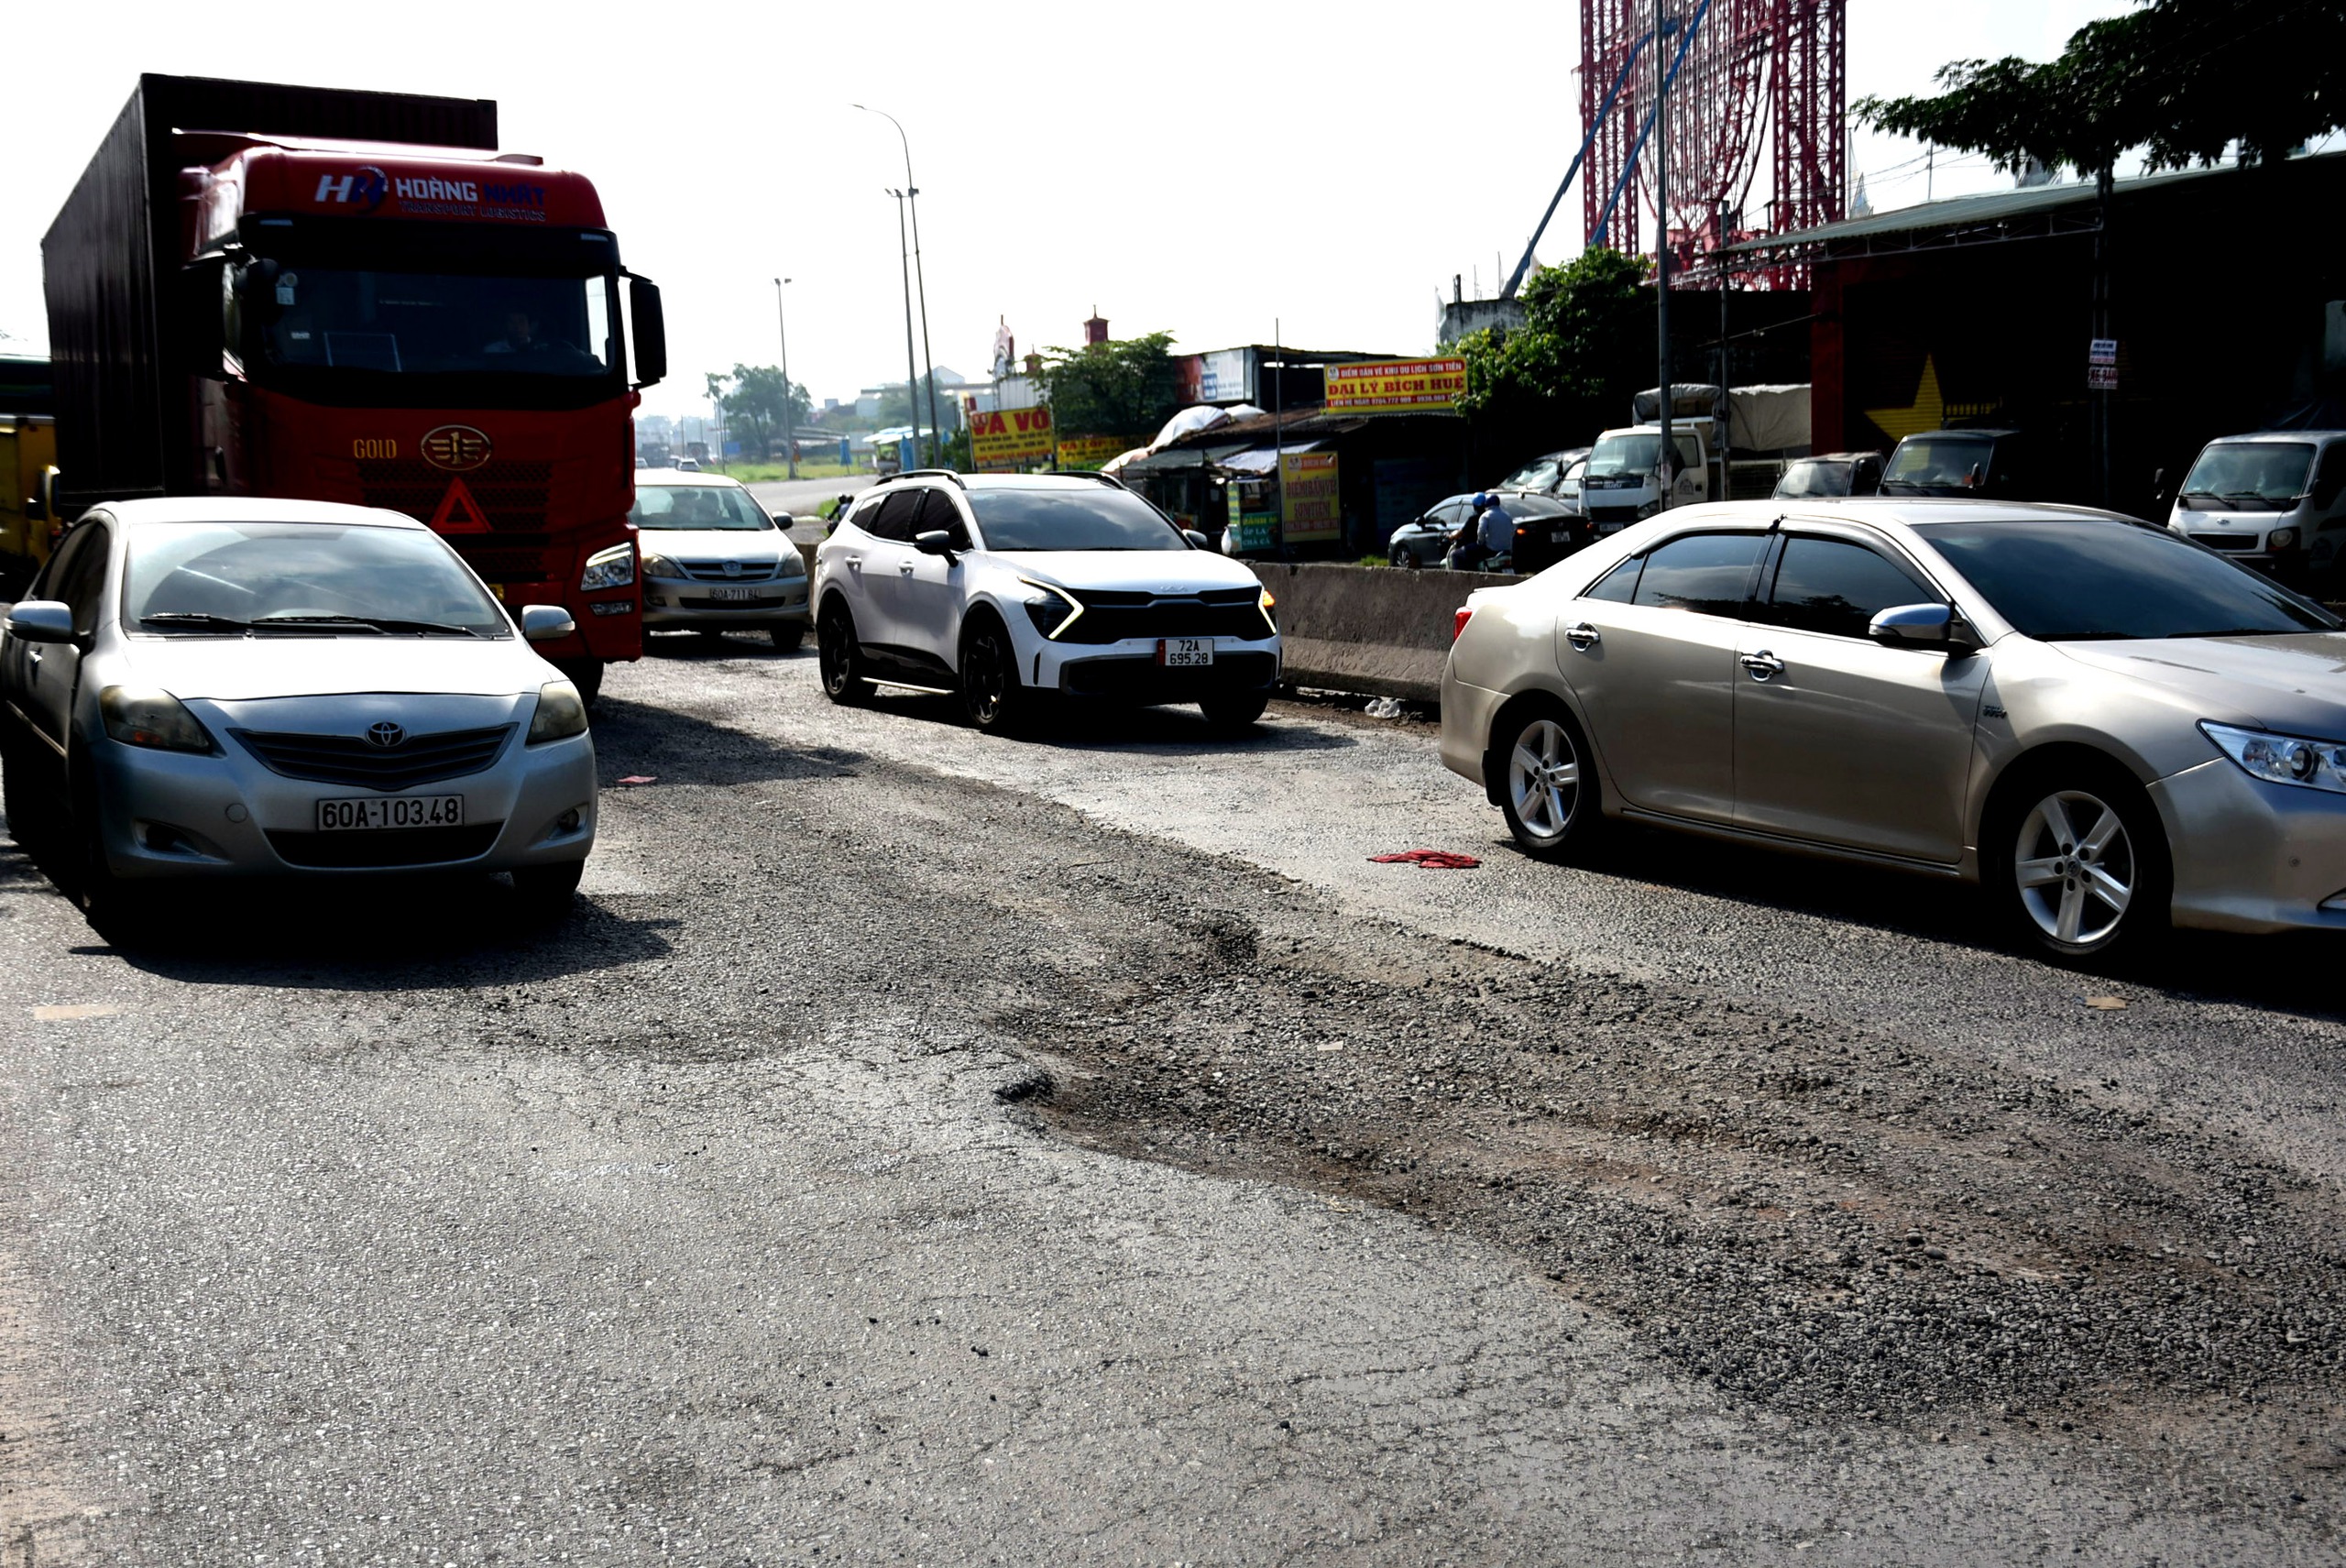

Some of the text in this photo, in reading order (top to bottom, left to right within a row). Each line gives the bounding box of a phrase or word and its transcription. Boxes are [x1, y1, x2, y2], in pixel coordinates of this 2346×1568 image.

[395, 176, 478, 203] HOÀNG
[400, 201, 546, 222] TRANSPORT LOGISTICS
[1360, 380, 1378, 394] LÝ
[354, 439, 397, 459] GOLD
[1178, 640, 1200, 652] 72A
[1169, 652, 1208, 664] 695.28
[323, 798, 458, 828] 60A-103.48
